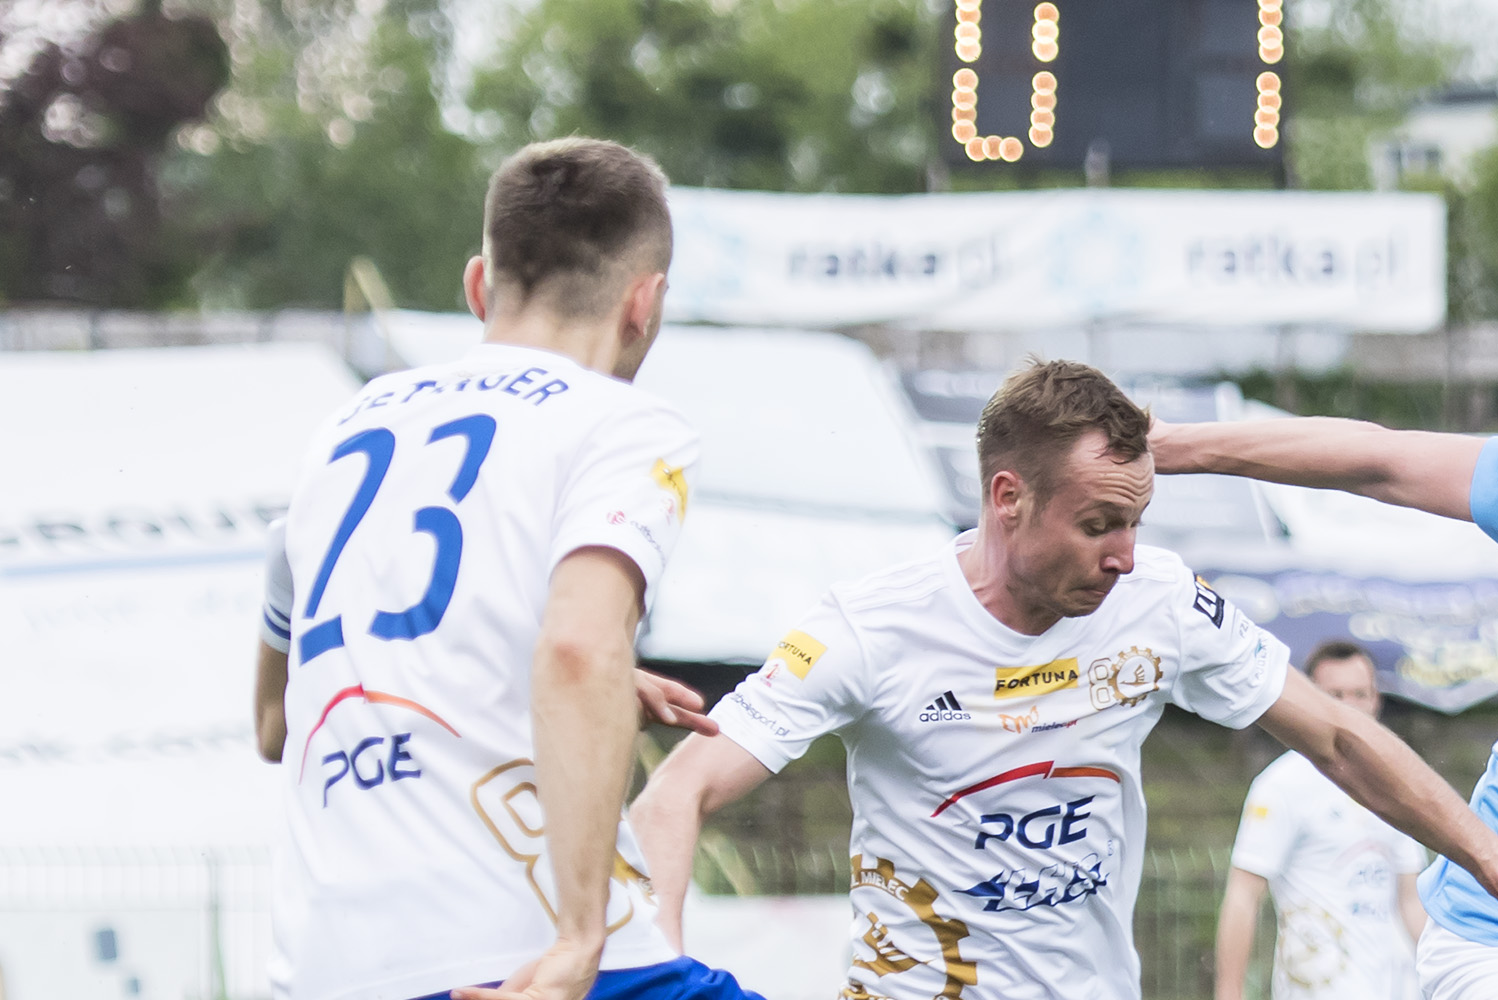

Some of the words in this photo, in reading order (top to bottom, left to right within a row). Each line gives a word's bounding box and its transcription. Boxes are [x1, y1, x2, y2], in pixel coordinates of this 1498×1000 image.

[298, 413, 497, 666] 23
[996, 669, 1078, 691] FORTUNA
[919, 709, 972, 722] adidas
[321, 732, 421, 808] PGE
[975, 795, 1096, 850] PGE
[861, 870, 910, 900] MIELEC
